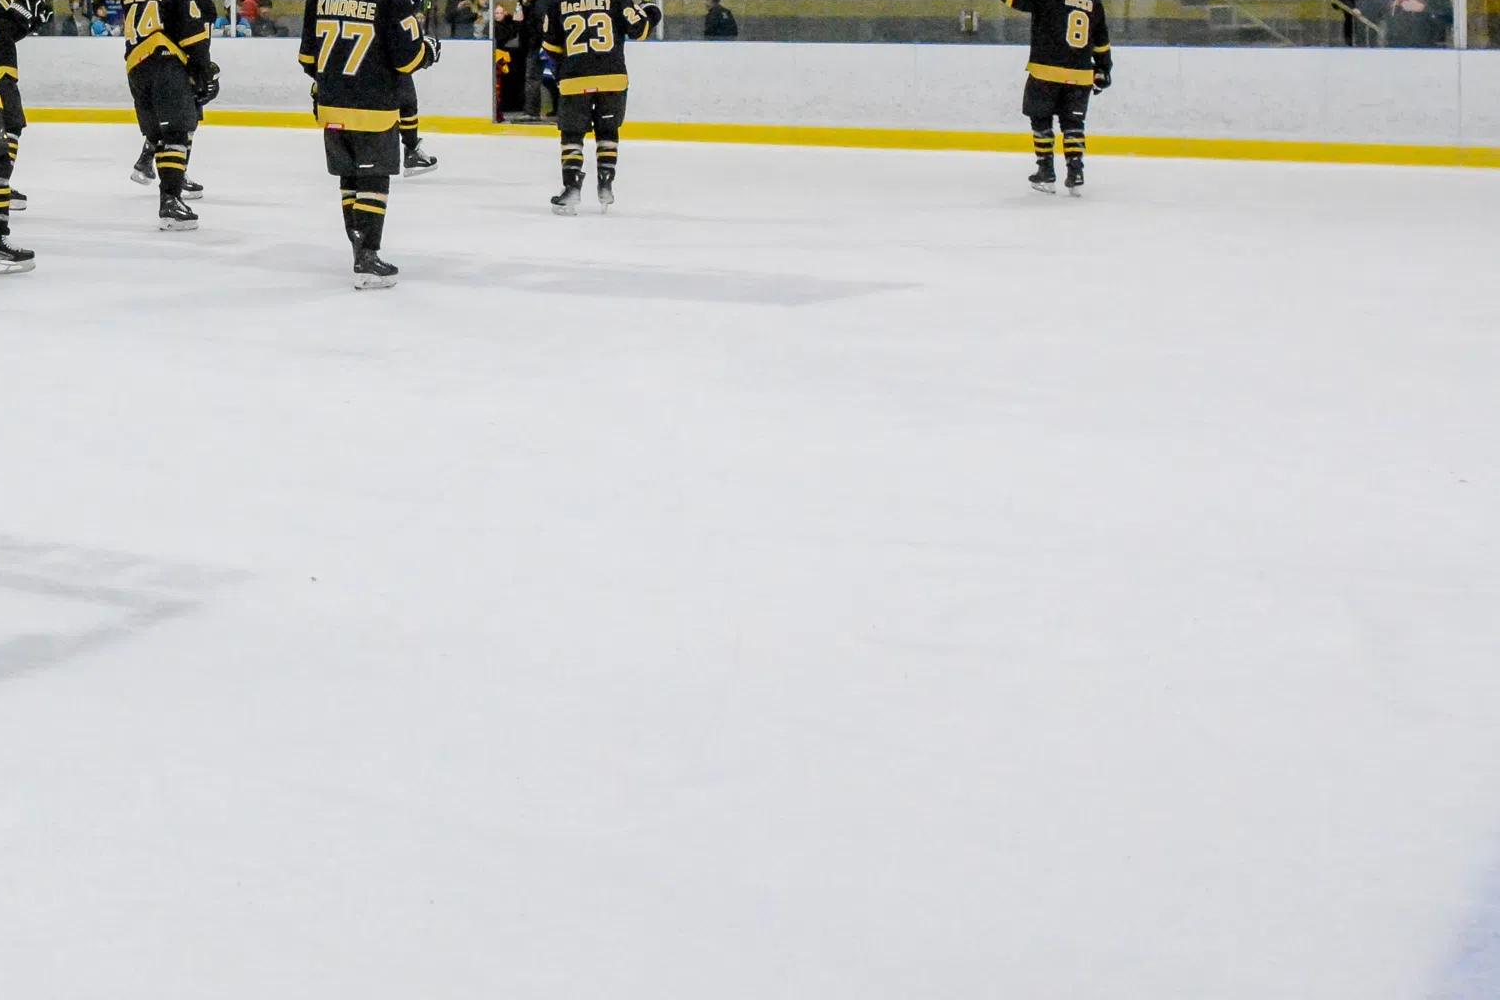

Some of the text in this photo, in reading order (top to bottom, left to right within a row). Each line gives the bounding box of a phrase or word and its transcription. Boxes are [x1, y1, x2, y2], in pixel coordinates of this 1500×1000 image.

[315, 20, 376, 76] 77
[563, 12, 614, 57] 23
[1066, 10, 1090, 49] 8
